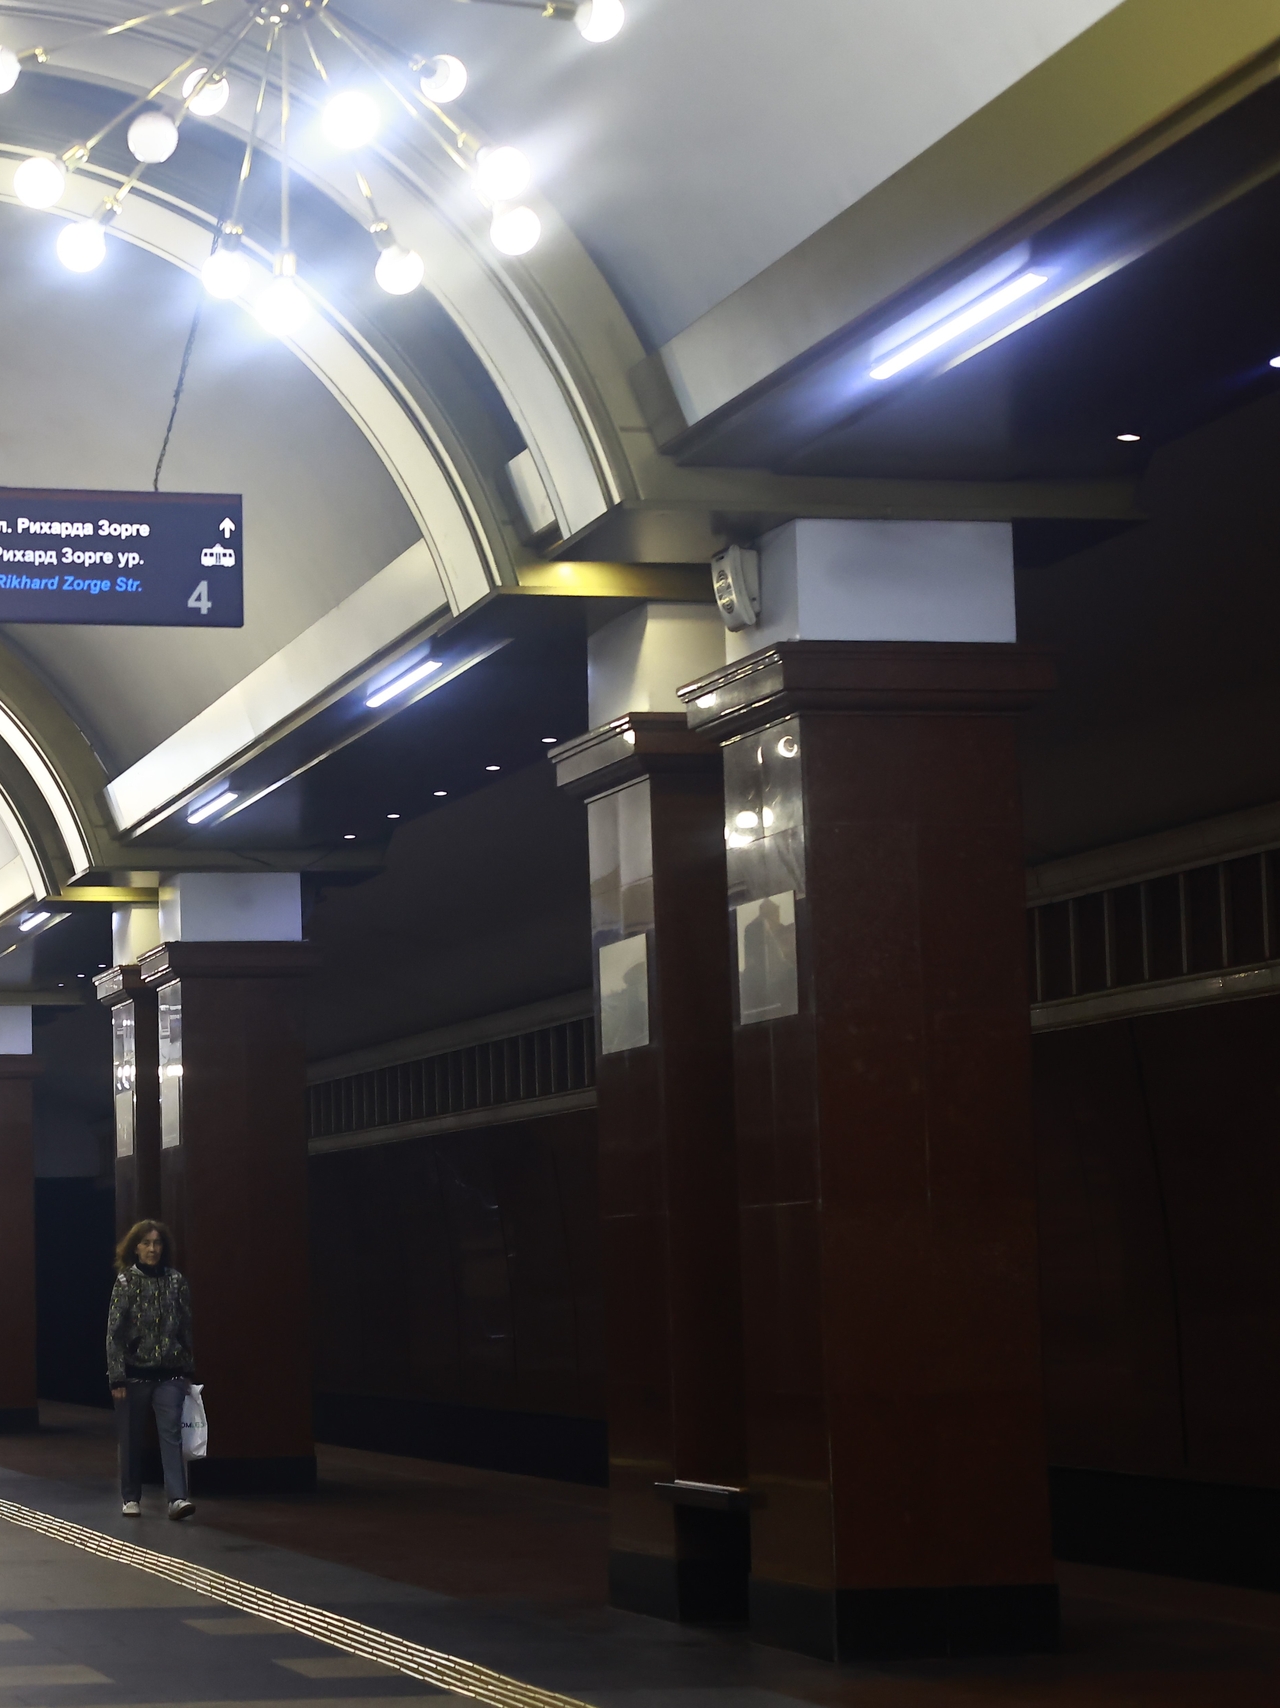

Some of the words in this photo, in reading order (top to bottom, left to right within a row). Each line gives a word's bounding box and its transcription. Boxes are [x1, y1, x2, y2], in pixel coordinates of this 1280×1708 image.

[16, 517, 94, 538] Рихарда
[97, 519, 151, 540] Зорге
[61, 546, 114, 568] Зорге
[117, 551, 145, 568] ур.
[62, 574, 112, 595] Zorge
[115, 575, 143, 592] Str.
[186, 579, 213, 616] 4
